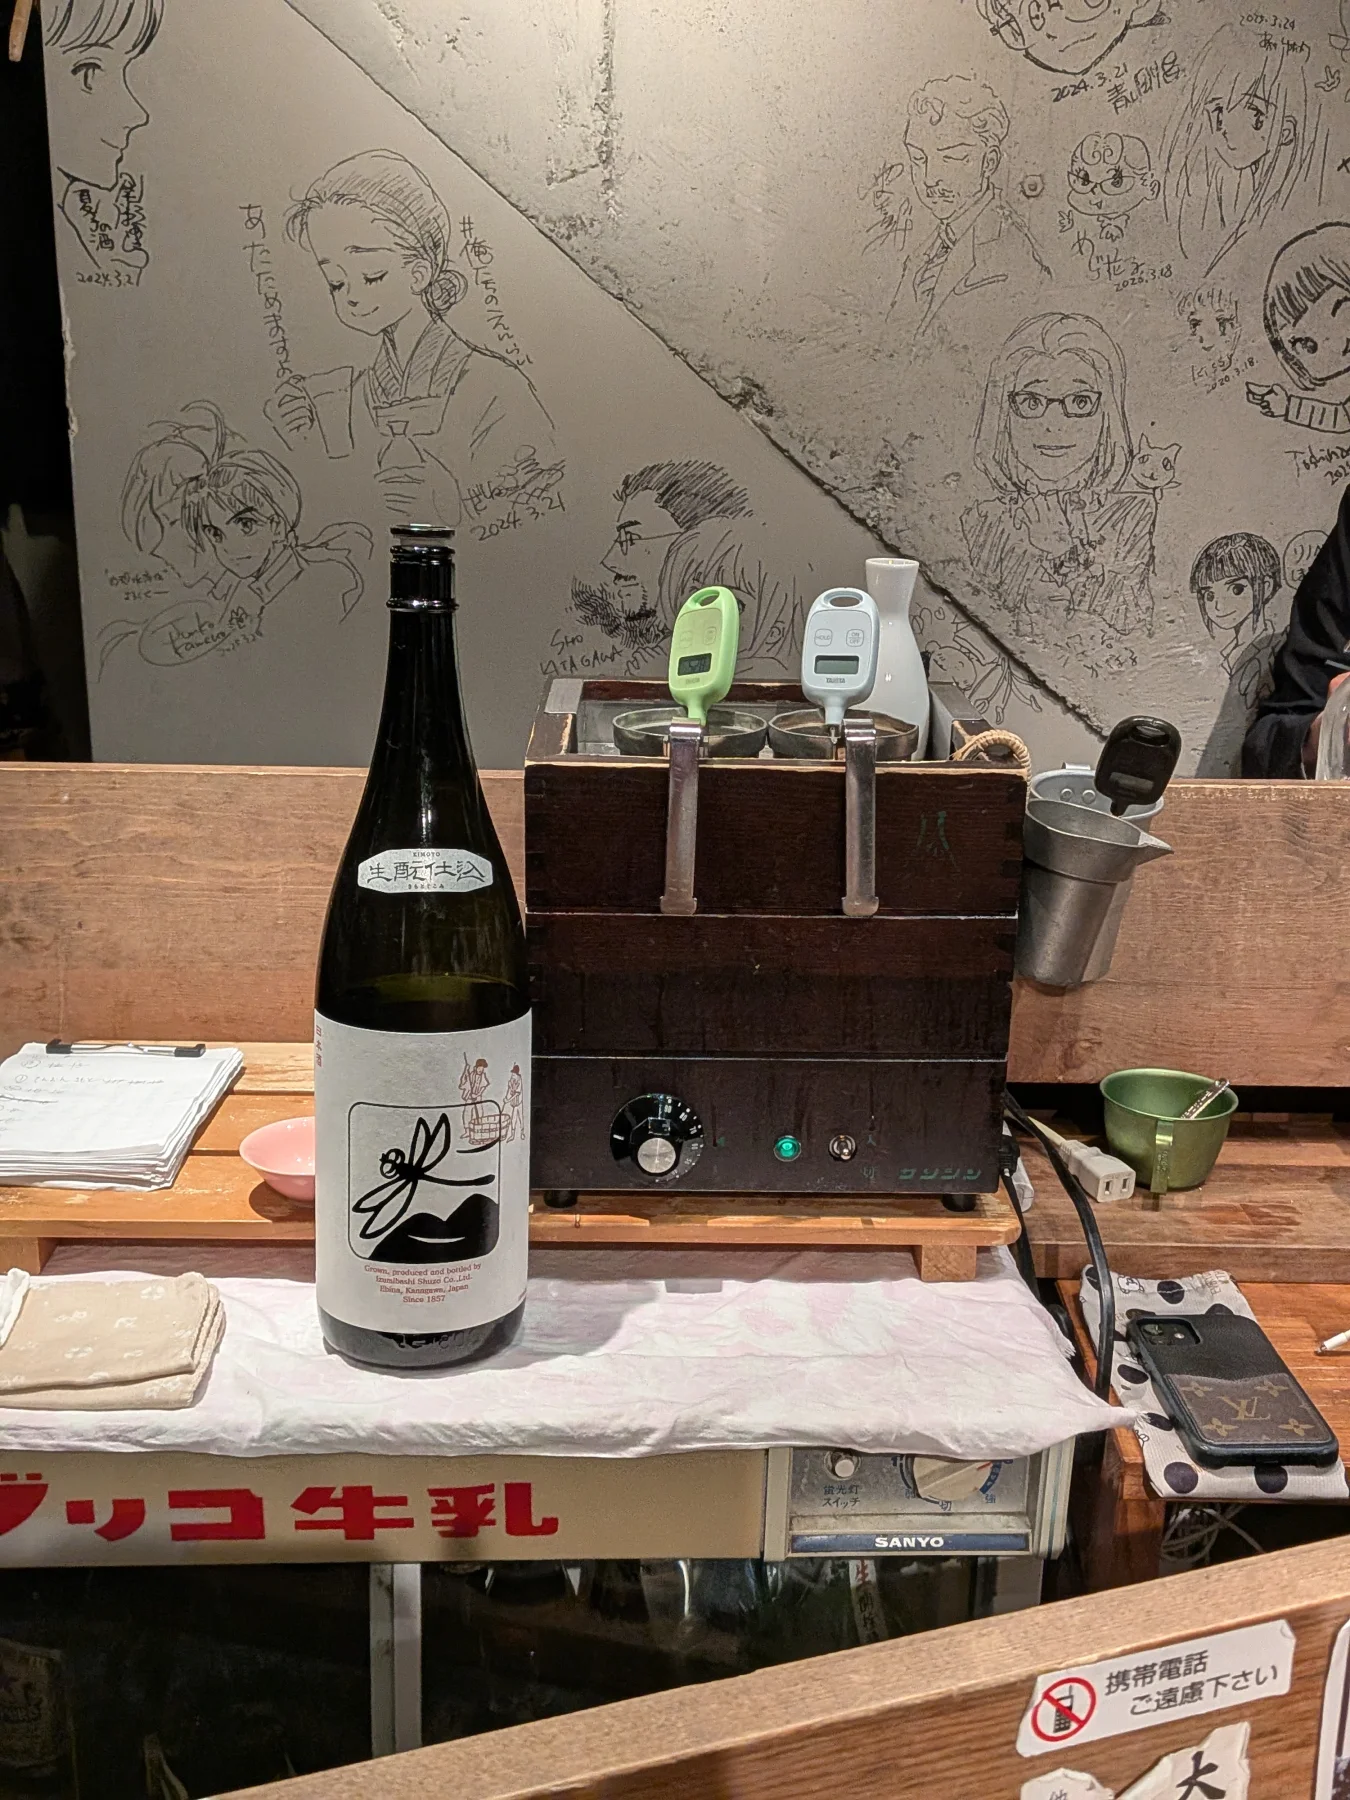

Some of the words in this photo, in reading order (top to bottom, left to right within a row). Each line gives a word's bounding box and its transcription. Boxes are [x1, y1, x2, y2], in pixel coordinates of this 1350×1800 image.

[1051, 62, 1128, 102] 2024.3.21
[364, 1264, 390, 1275] Grown,
[392, 1266, 428, 1276] produced
[430, 1266, 445, 1275] and
[447, 1263, 472, 1274] bottled
[474, 1261, 481, 1270] by
[448, 1284, 469, 1293] Japan
[427, 1295, 446, 1303] 1857
[874, 1537, 945, 1548] SANYO
[1105, 1650, 1209, 1696] 携帯電話
[1129, 1665, 1278, 1716] ご遠慮下さい
